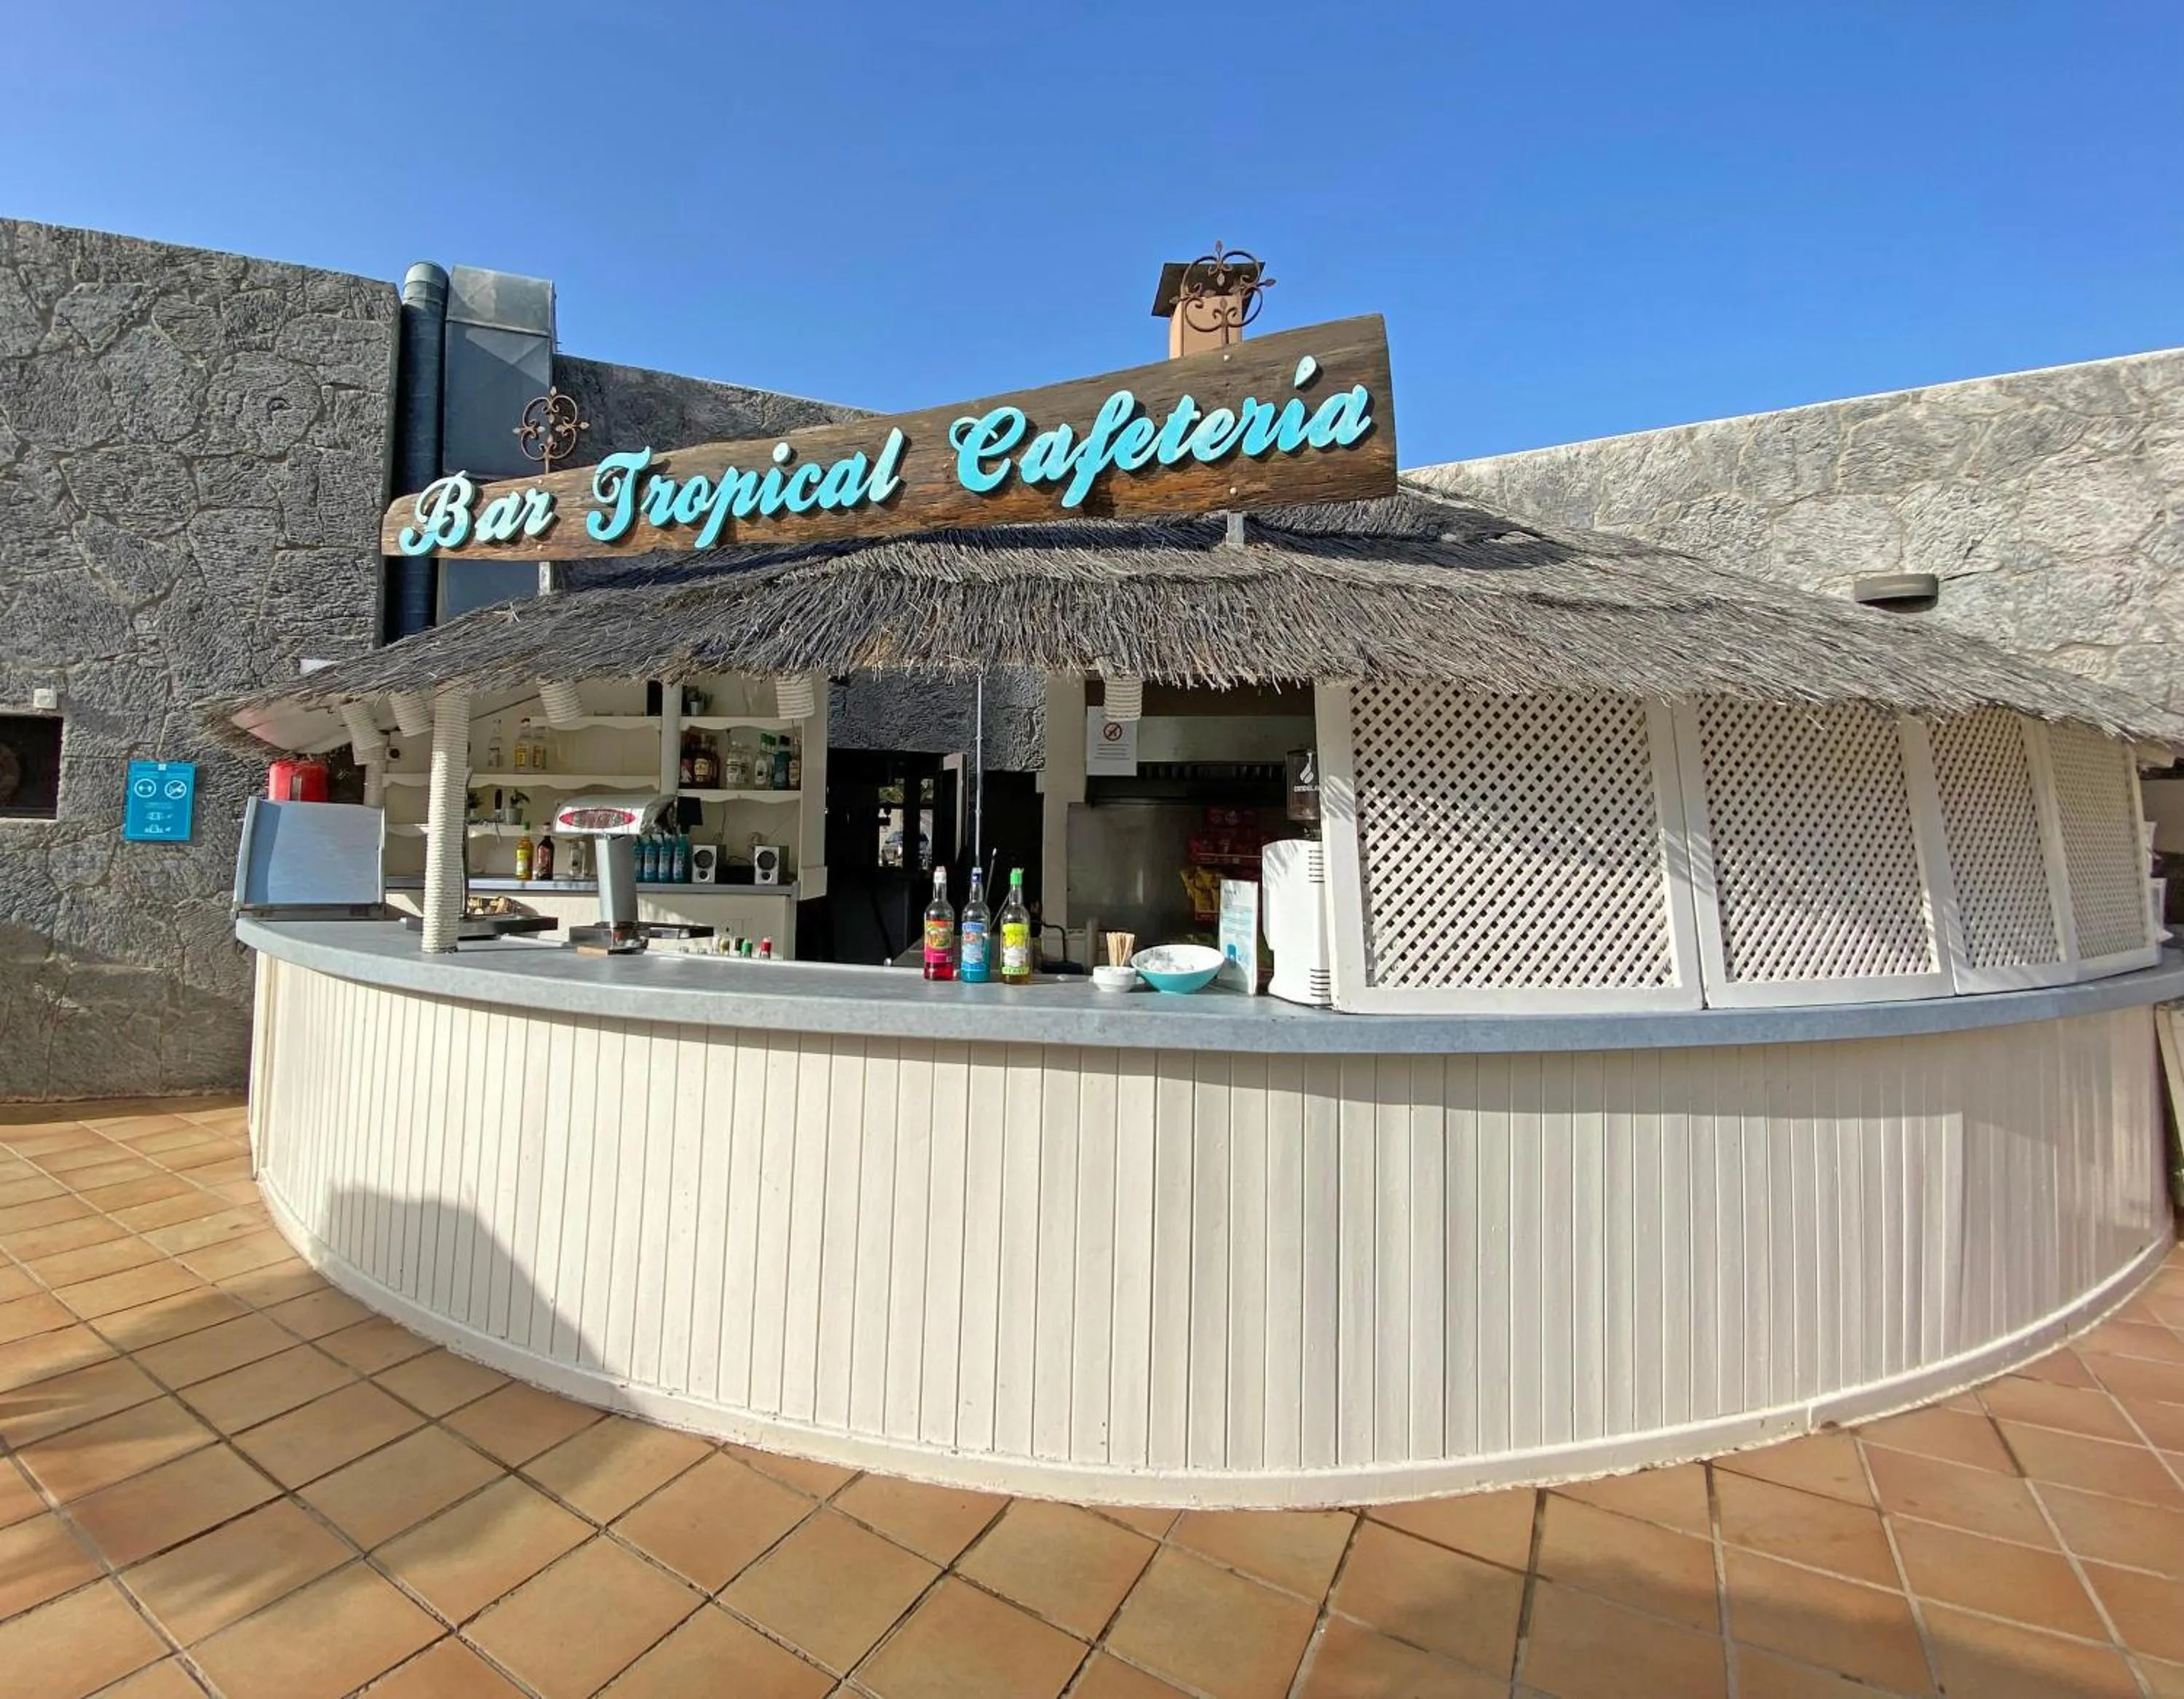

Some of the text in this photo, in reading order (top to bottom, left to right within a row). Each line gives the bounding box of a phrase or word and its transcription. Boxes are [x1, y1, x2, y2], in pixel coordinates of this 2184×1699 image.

[398, 355, 1372, 556] Bar Tropical Cafetería
